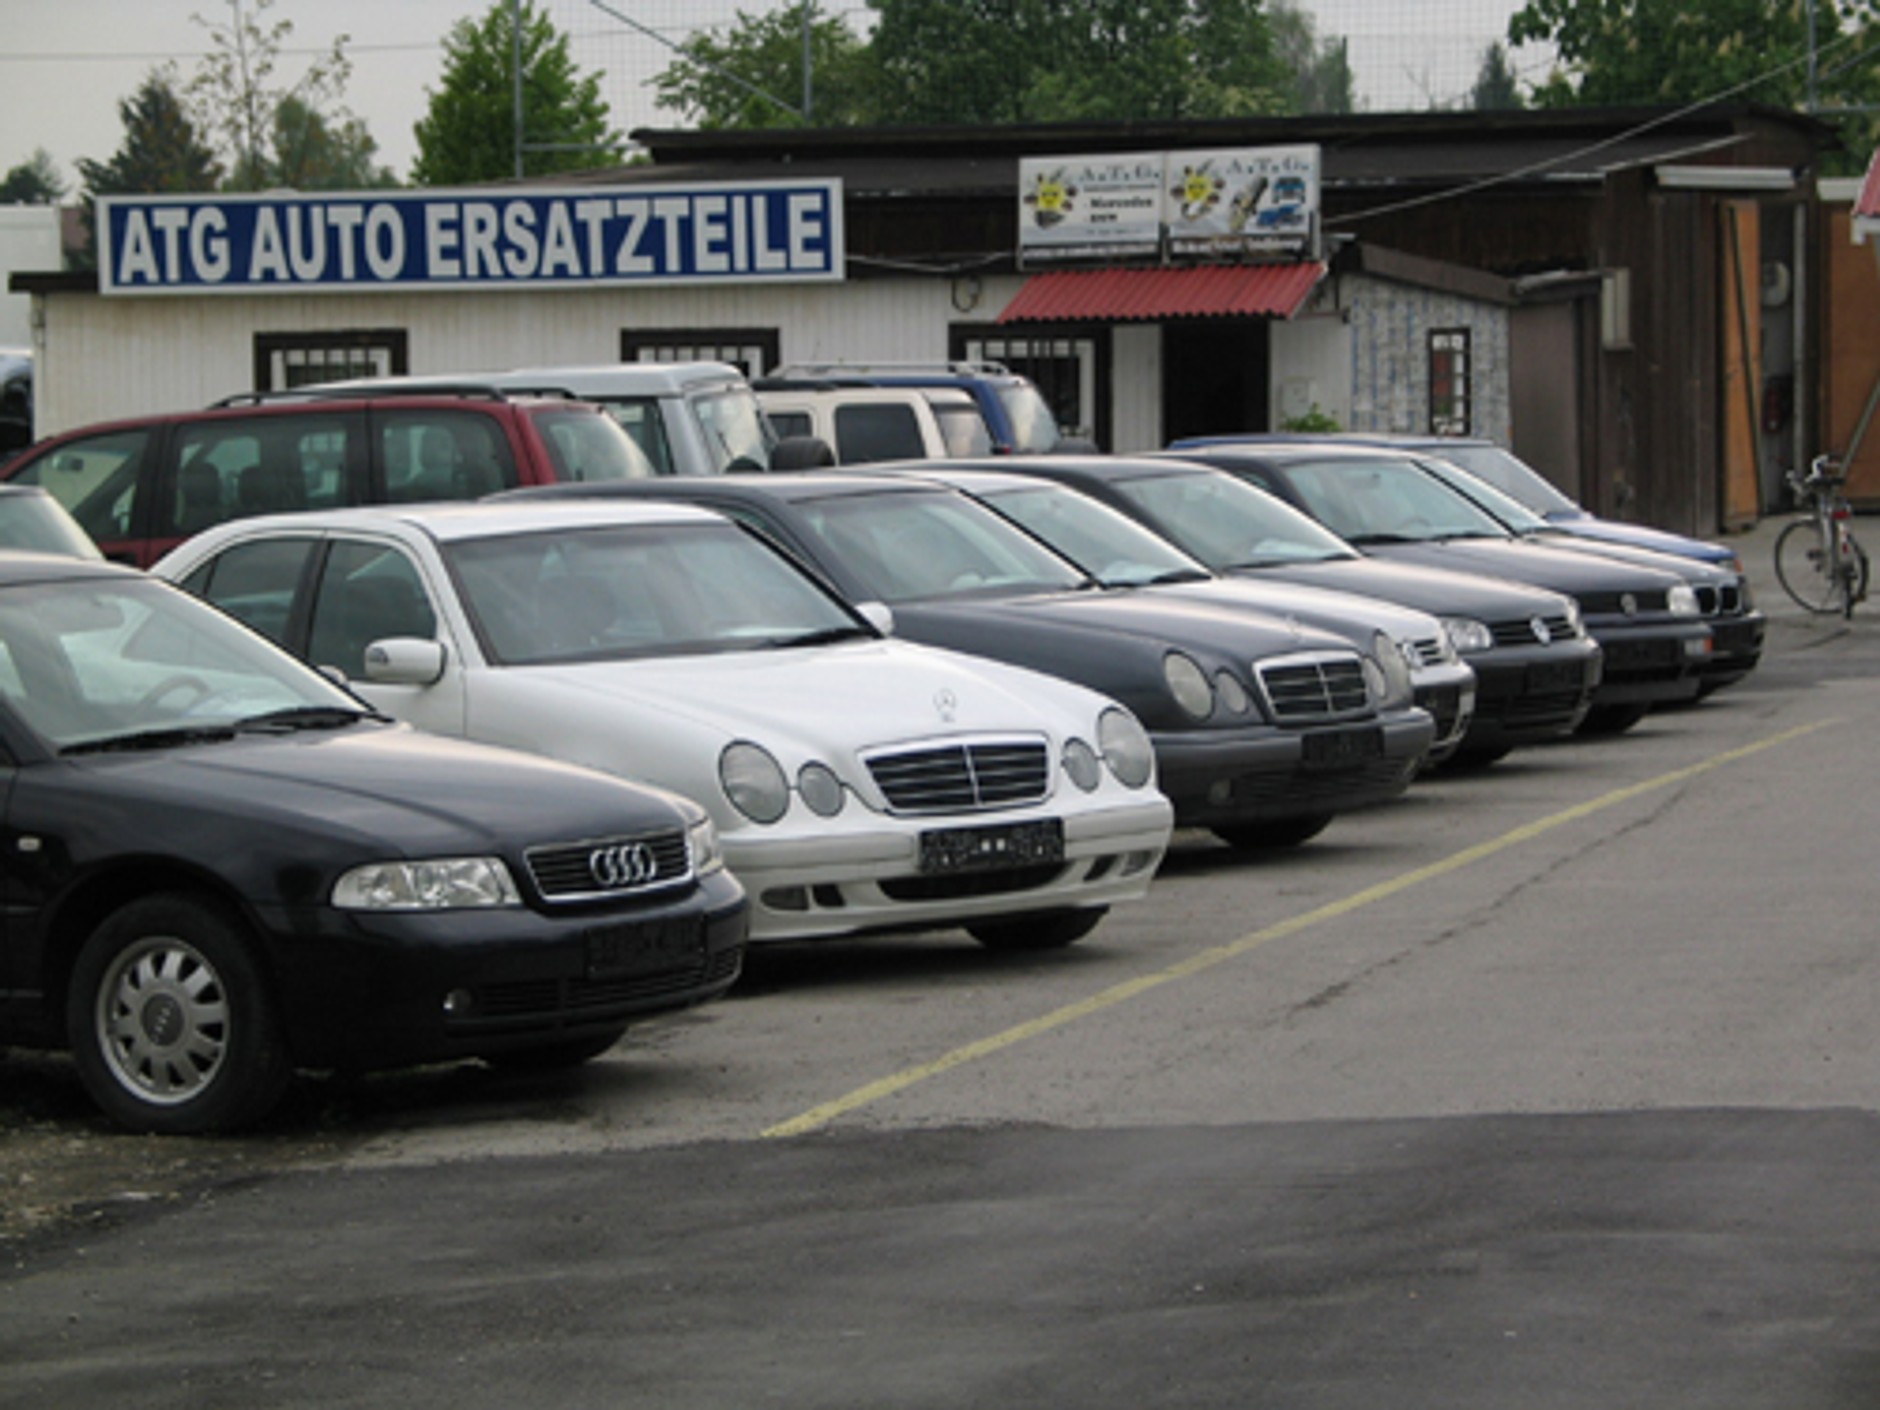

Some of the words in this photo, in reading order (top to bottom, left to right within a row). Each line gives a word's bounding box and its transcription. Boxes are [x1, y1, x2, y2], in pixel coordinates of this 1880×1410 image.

[119, 206, 231, 283] ATG
[249, 203, 406, 280] AUTO
[425, 193, 826, 278] ERSATZTEILE
